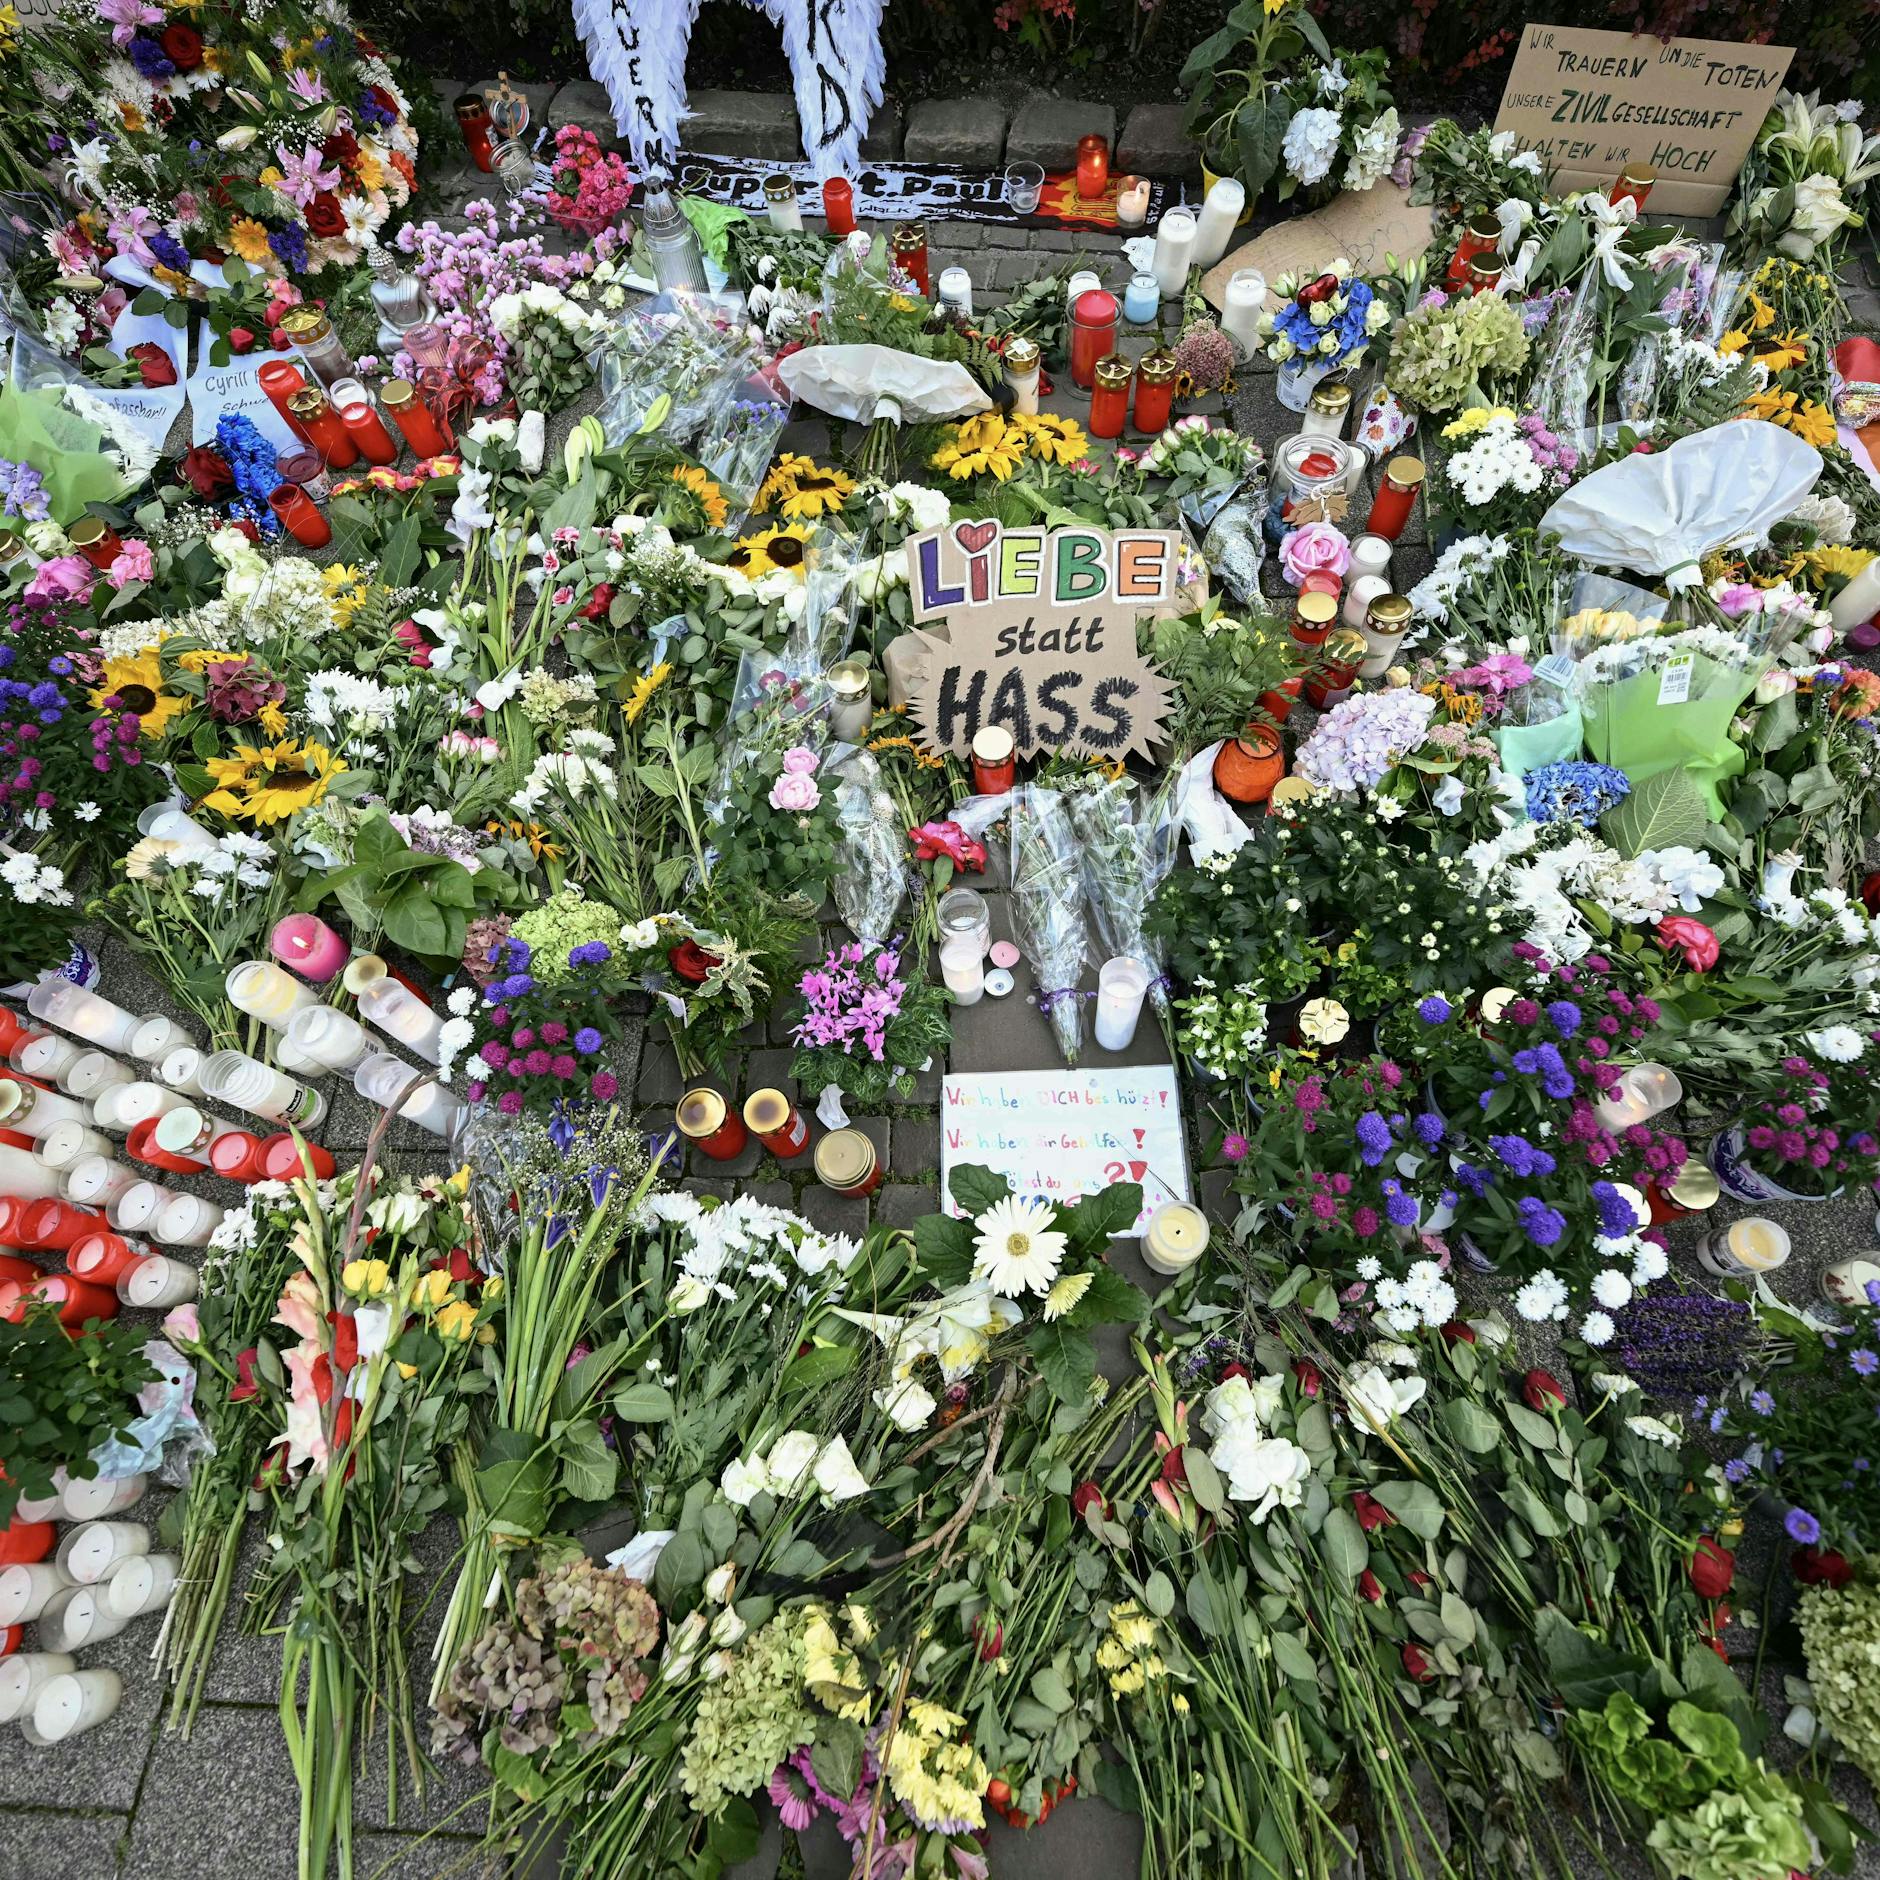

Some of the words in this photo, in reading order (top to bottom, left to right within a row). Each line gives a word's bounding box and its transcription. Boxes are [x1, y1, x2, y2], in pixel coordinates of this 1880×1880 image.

[1530, 28, 1554, 50] WIR
[1557, 50, 1648, 79] TRAUERN
[1681, 52, 1706, 69] DIE
[1704, 61, 1779, 91] TOTEN
[1507, 92, 1556, 109] UNSERE
[1514, 135, 1599, 161] HALTEN
[1604, 146, 1631, 163] WIR
[1649, 139, 1717, 173] HOCH
[205, 370, 248, 396] Cyrill
[994, 616, 1105, 658] statt
[935, 664, 1141, 751] HASS
[1046, 1175, 1061, 1190] du
